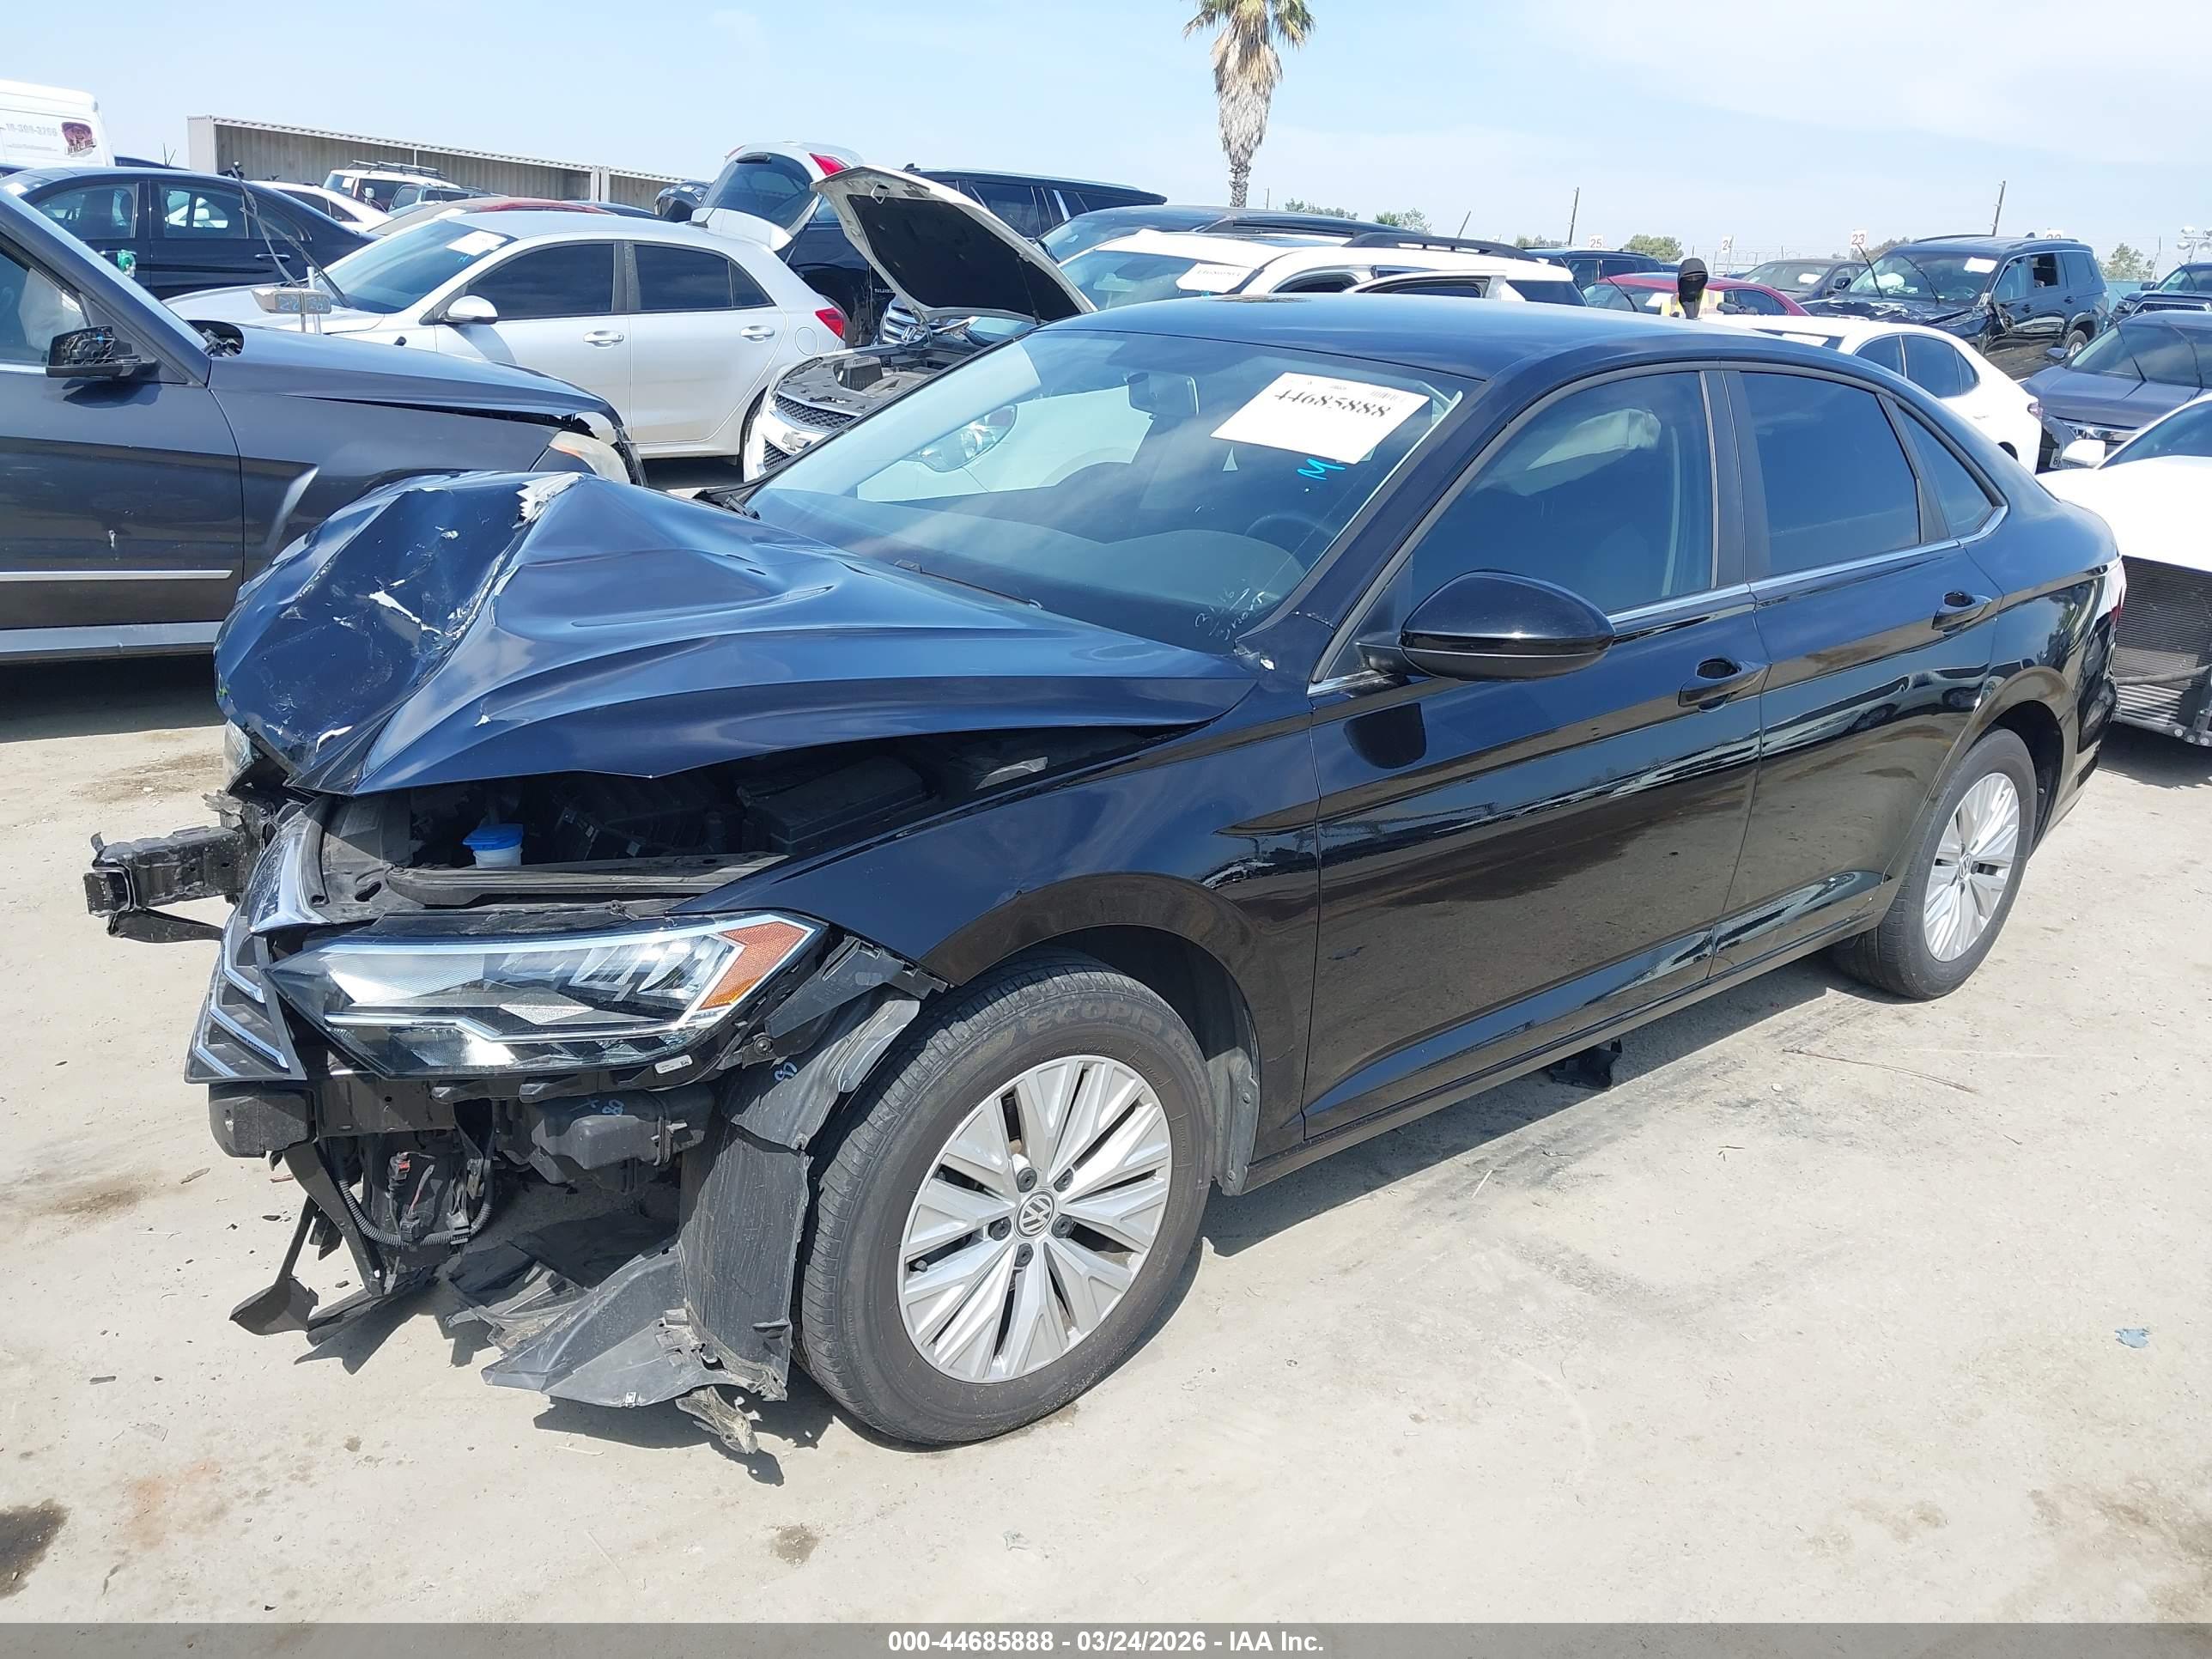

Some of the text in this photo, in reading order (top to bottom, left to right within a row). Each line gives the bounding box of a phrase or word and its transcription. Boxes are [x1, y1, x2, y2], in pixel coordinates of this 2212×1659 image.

[1590, 239, 1602, 248] 25
[1851, 234, 1865, 245] 23
[1274, 389, 1391, 417] 44685888
